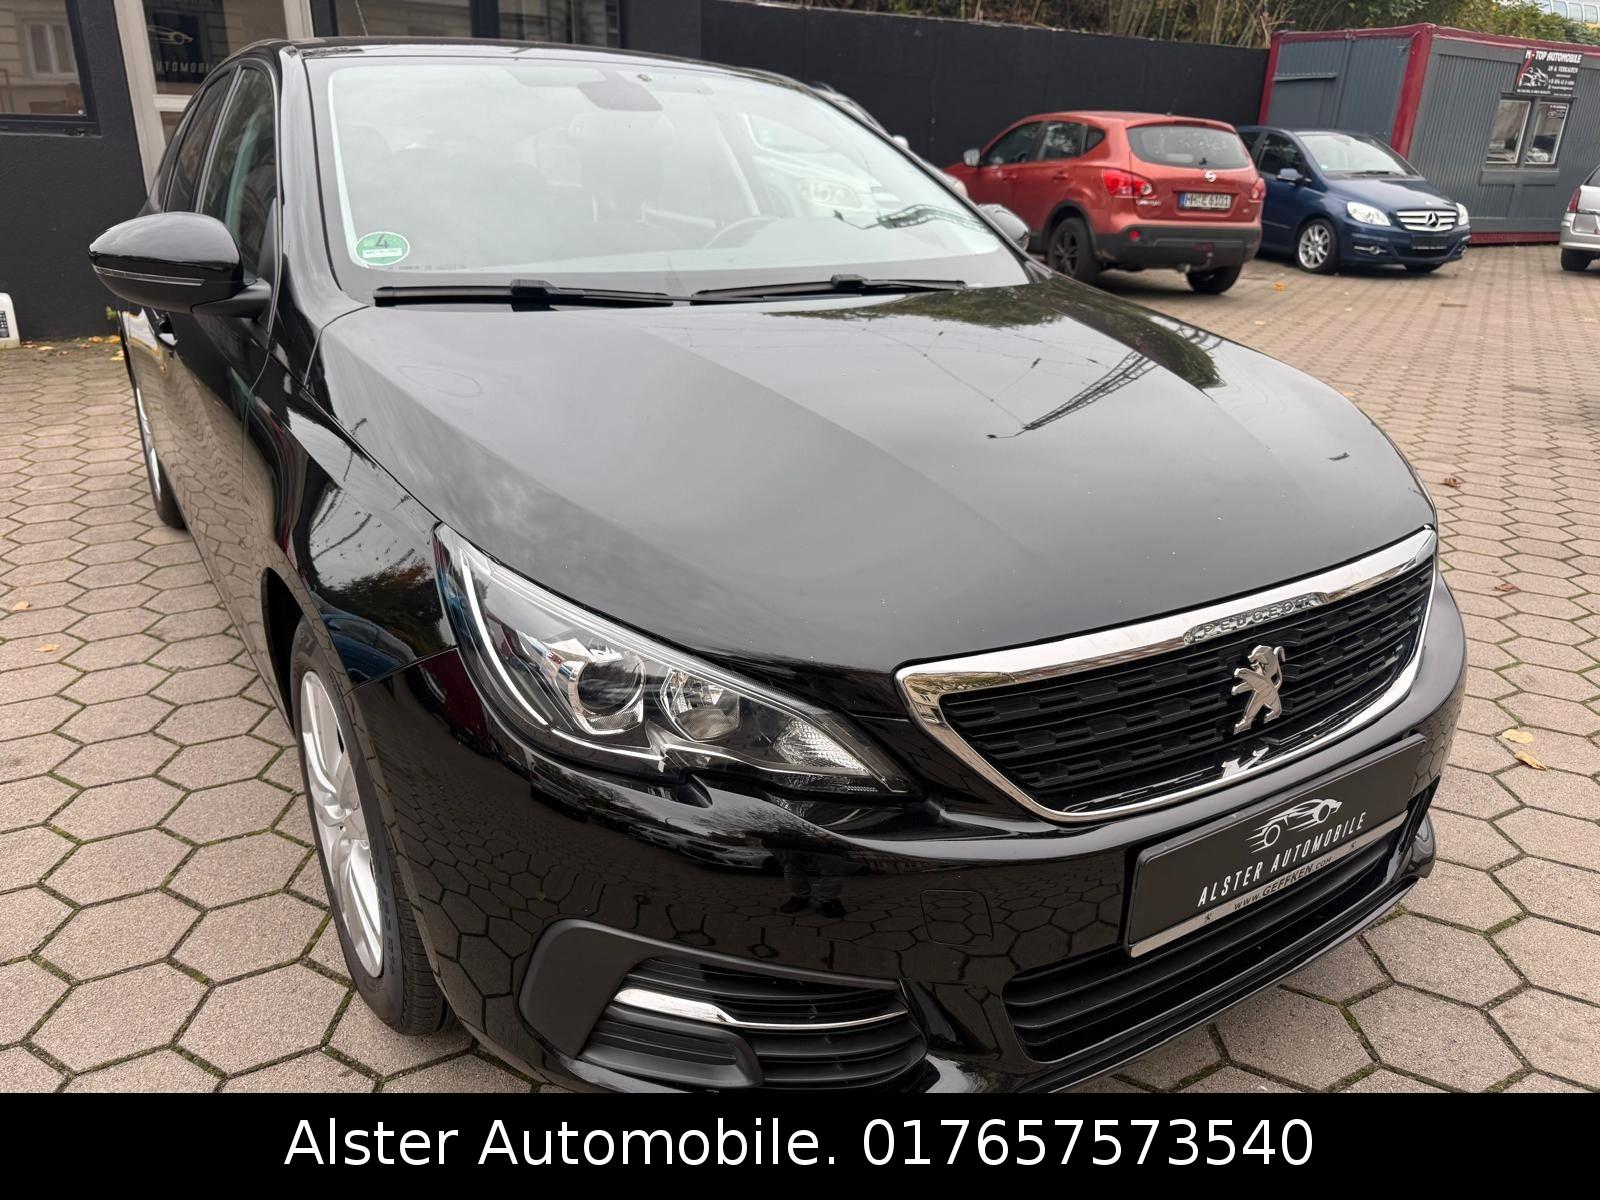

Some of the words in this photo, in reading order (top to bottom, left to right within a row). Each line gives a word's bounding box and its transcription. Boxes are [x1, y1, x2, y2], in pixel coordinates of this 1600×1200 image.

[1535, 50, 1548, 60] TOP
[1547, 51, 1582, 63] AUTOMOBILE
[375, 234, 389, 249] 4
[1202, 598, 1311, 634] PEUGEOT
[1197, 861, 1264, 908] ALSTER
[1270, 811, 1367, 873] AUTOMOBILE
